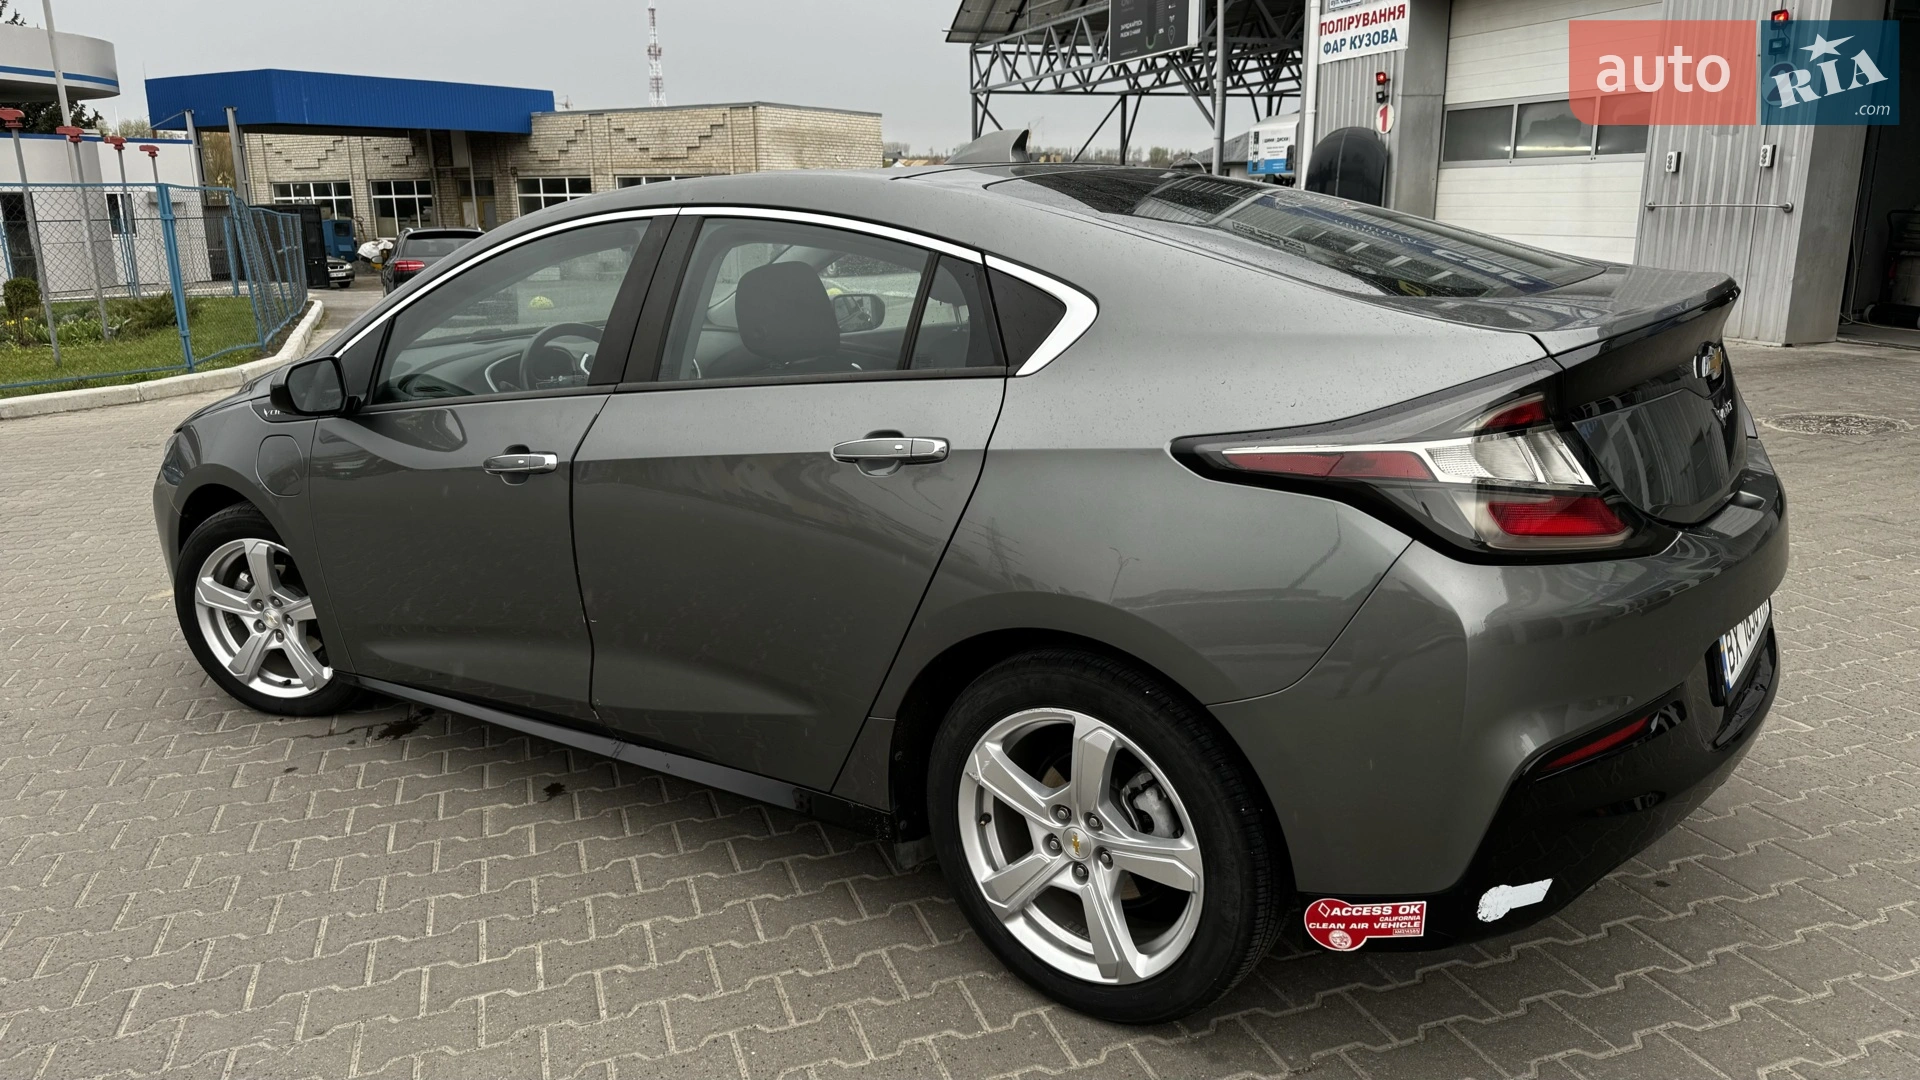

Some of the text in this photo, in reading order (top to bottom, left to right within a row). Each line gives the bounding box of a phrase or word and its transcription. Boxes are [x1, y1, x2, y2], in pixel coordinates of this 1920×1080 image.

[1320, 4, 1406, 36] ПОЛІРУВАННЯ
[1323, 27, 1398, 55] ФАР КУЗОВА
[1379, 104, 1389, 132] 1
[1330, 904, 1422, 917] ACCESS OK
[1373, 921, 1421, 929] VEHICLE
